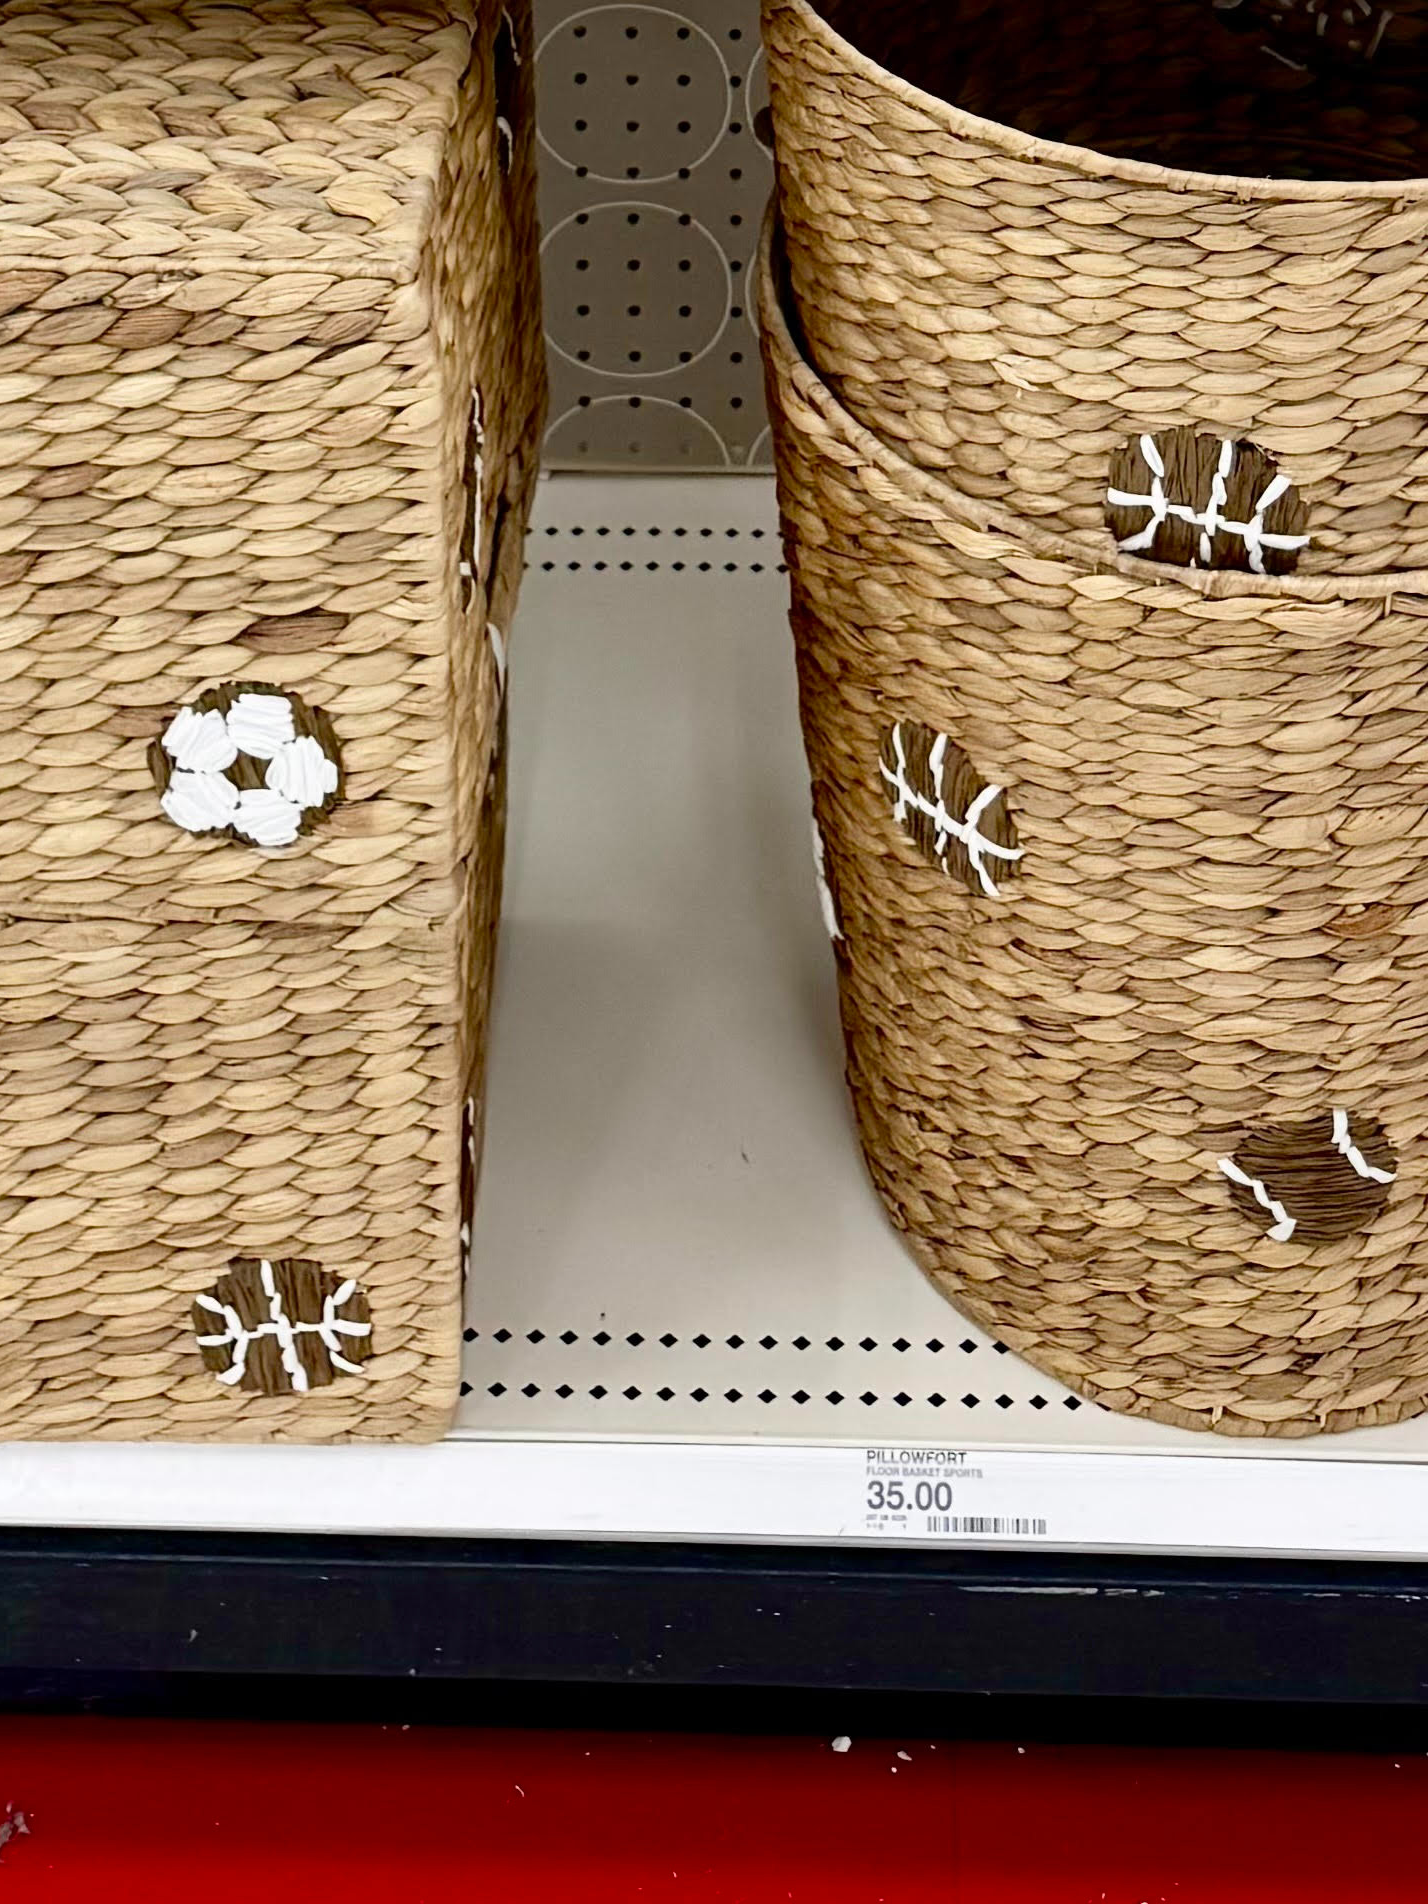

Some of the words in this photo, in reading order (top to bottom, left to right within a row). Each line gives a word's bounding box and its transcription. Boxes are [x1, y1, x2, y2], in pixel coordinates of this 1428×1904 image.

[867, 1450, 967, 1465] PILLOWFORT
[867, 1466, 899, 1476] FLOOR
[902, 1467, 940, 1477] BASKET
[943, 1468, 983, 1478] SPORTS
[867, 1481, 952, 1511] 35.00
